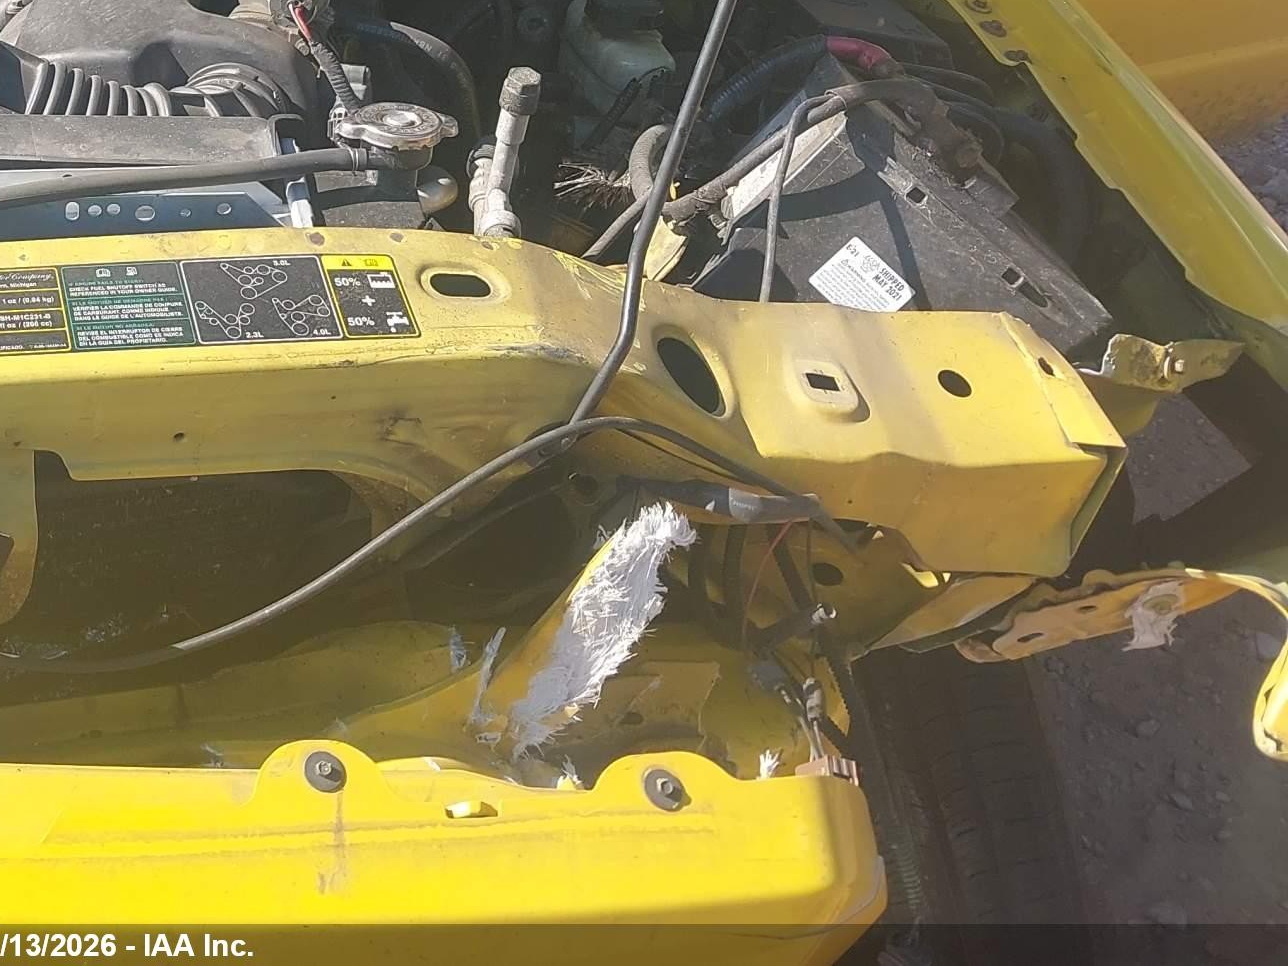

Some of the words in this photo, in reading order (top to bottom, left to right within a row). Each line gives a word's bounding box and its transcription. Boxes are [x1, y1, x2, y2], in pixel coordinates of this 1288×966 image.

[334, 277, 362, 287] 50%
[879, 267, 905, 292] SHIPPED
[871, 274, 889, 289] MAY
[885, 287, 903, 301] 2021
[347, 316, 376, 327] 50%
[245, 331, 264, 339] 2.3L
